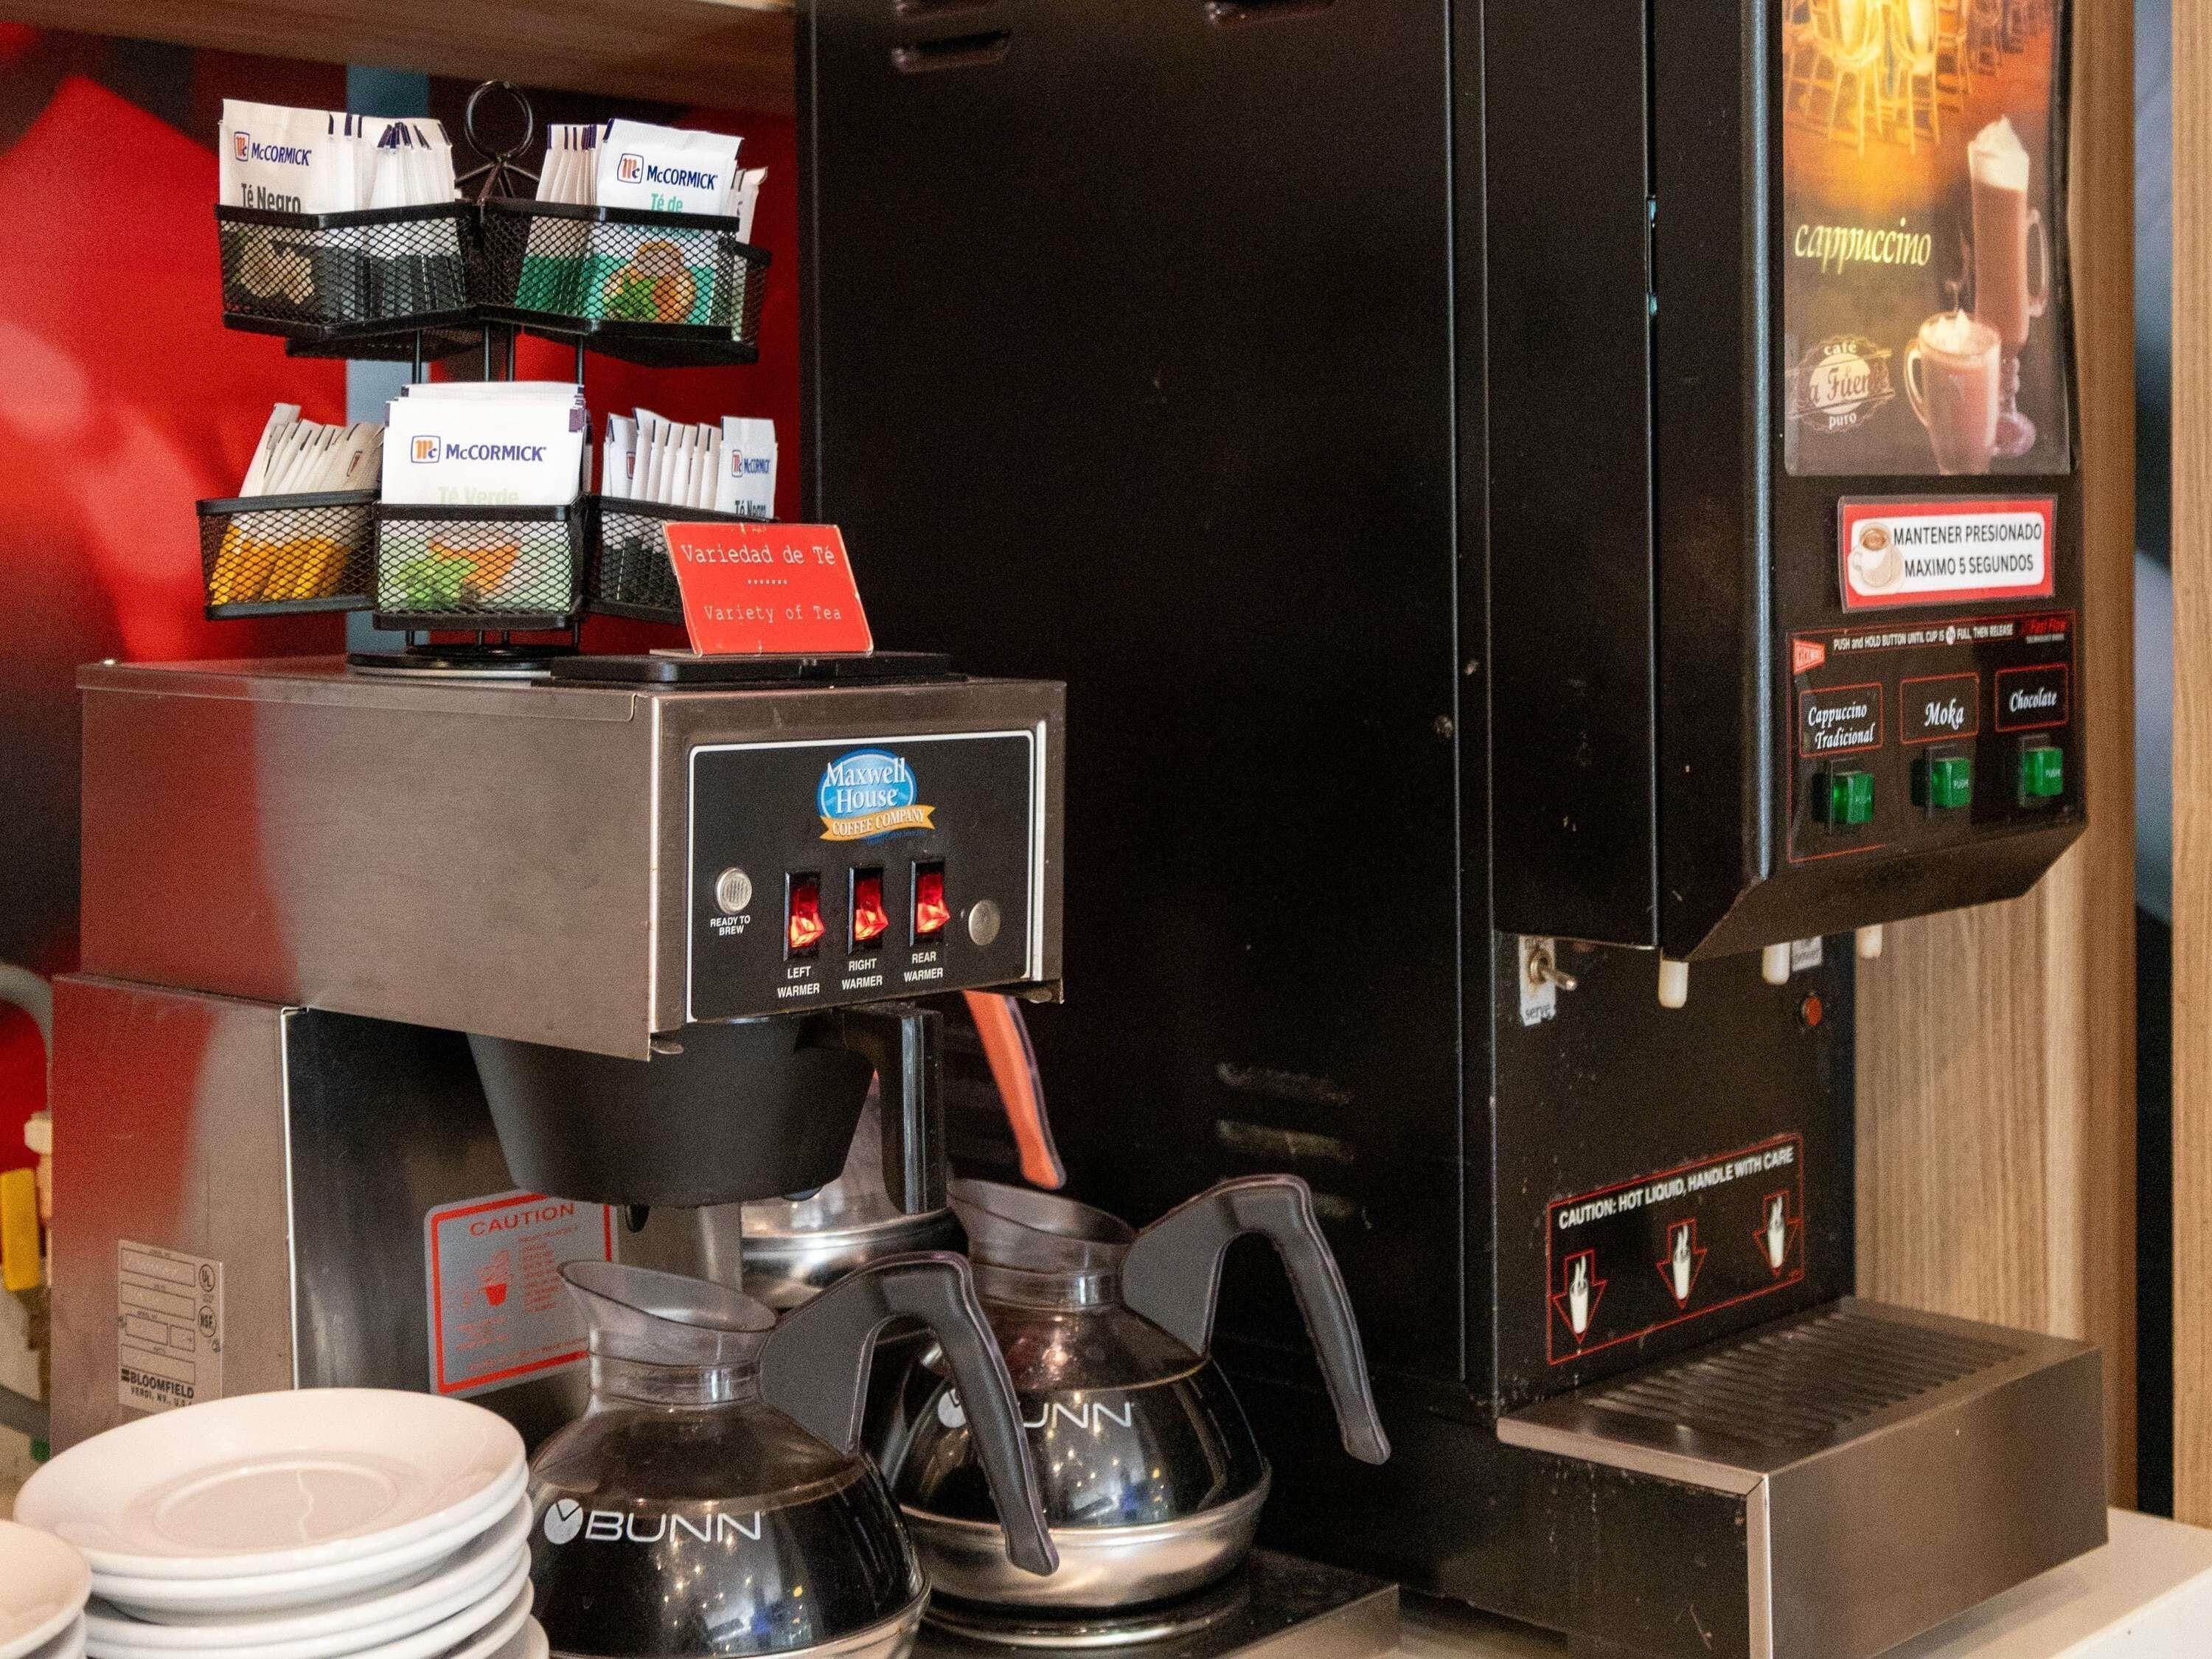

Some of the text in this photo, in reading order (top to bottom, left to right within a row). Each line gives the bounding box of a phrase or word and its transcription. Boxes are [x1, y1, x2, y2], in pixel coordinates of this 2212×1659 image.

[251, 142, 311, 166] McCORMICK
[647, 165, 718, 190] McCORMICK
[241, 183, 254, 209] Té
[651, 192, 683, 213] Té de
[1794, 217, 1932, 274] cappuccino
[1823, 341, 1857, 355] café
[1828, 413, 1857, 430] puro
[445, 443, 546, 462] McCORMICK
[1893, 523, 2042, 546] MANTENER PRESIONADO
[681, 544, 836, 565] Variedad de Té
[1905, 554, 2034, 578] MAXIMO 5 SEGUNDOS
[704, 605, 842, 623] Variety of Tea
[1833, 638, 1851, 650] PUSH
[1851, 637, 1864, 649] and
[1865, 635, 1881, 647] HOLD
[1882, 633, 1907, 647] BUTTON
[1907, 630, 1924, 644] UNTIL
[1925, 629, 1938, 643] CUP
[1938, 629, 1945, 641] IS
[1973, 625, 1989, 639] THEN
[1989, 623, 2014, 637] RELEASE
[2009, 687, 2058, 713] Chocolate
[1808, 702, 1868, 728] Cappuccino
[1924, 698, 1964, 731] Moka
[1815, 723, 1876, 749] Tradicional
[824, 757, 906, 787] Maxwell
[835, 787, 899, 815] House
[832, 808, 925, 836] COFFEE COMPANY
[710, 914, 751, 928] READY TO
[718, 924, 745, 936] BREW
[848, 958, 878, 972] RIGHT
[911, 951, 936, 964] REAR
[787, 965, 812, 979] LEFT
[841, 975, 883, 991] WARMER
[904, 967, 944, 982] WARMER
[777, 983, 821, 998] WARMER
[1558, 1146, 1794, 1230] CAUTION: HOT LIQUID, HANDLE WITH CARE
[470, 1203, 575, 1238] CAUTION
[130, 1371, 195, 1399] BLOOMFIELD
[1023, 1402, 1132, 1430] UNN
[585, 1510, 761, 1543] BUNN
